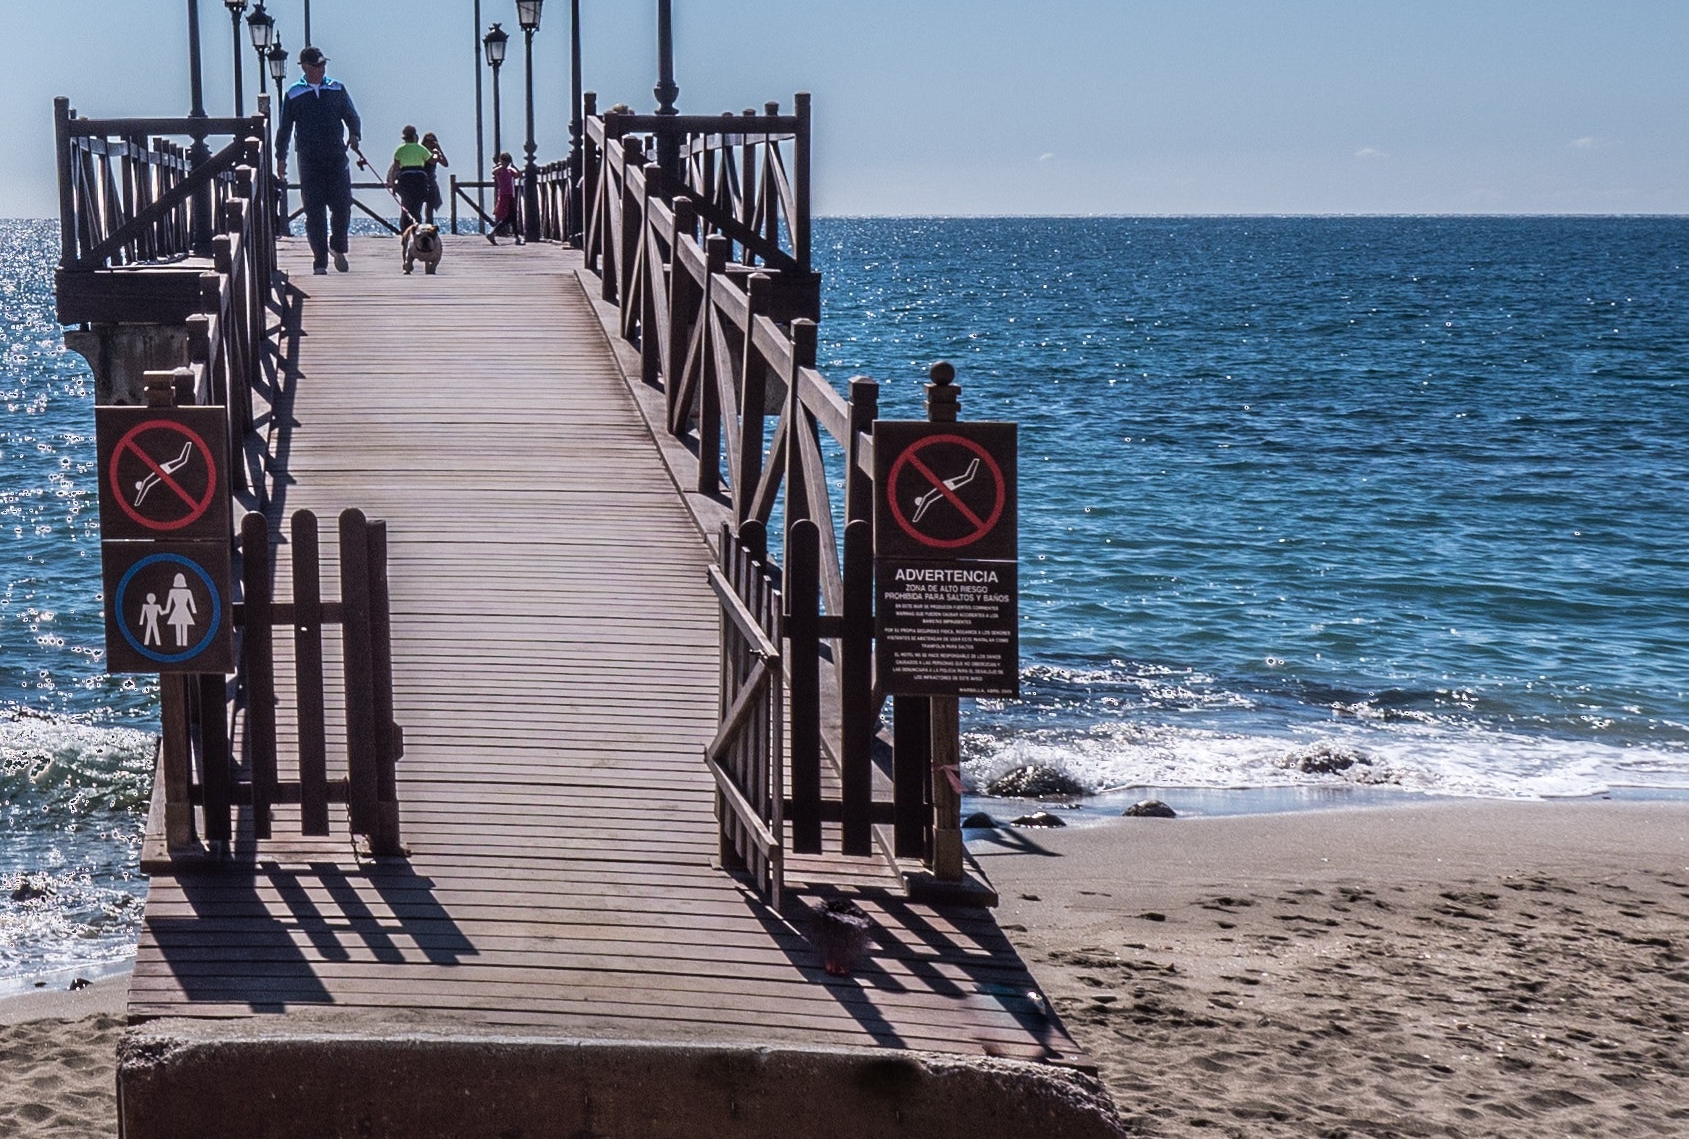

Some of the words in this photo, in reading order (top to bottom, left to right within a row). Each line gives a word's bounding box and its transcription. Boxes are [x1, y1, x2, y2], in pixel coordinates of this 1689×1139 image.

[895, 569, 998, 583] ADVERTENCIA
[905, 584, 926, 592] ZONA
[928, 584, 938, 592] DE
[940, 585, 958, 593] ALTO
[960, 585, 988, 594] RIESGO
[884, 592, 923, 600] PROHIBIDA
[924, 593, 945, 601] PARA
[946, 593, 974, 602] SALTOS
[976, 594, 981, 602] Y
[983, 592, 1010, 602] BAÑOS
